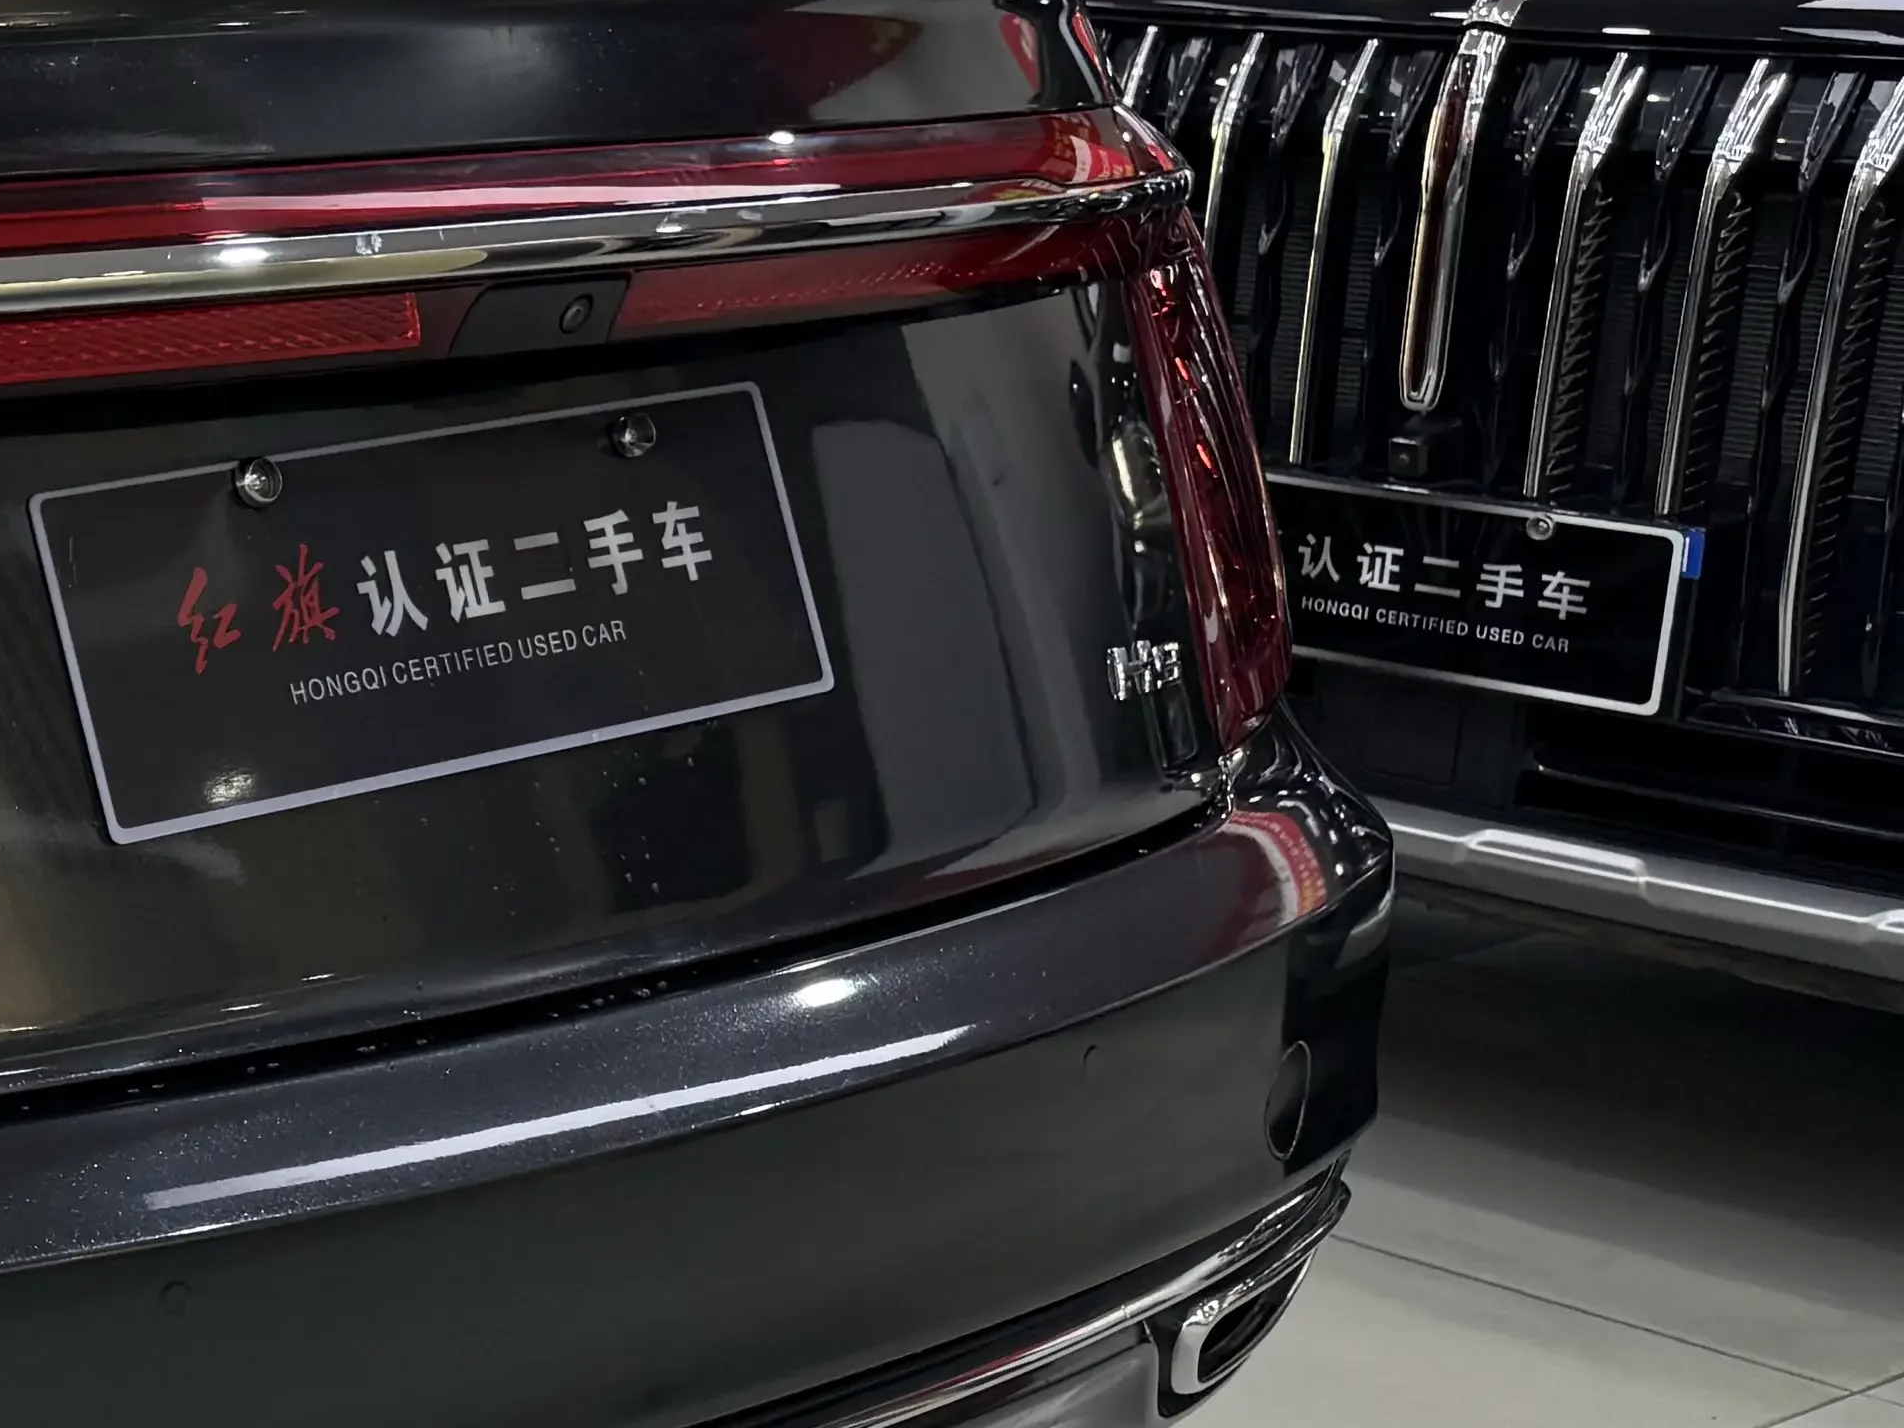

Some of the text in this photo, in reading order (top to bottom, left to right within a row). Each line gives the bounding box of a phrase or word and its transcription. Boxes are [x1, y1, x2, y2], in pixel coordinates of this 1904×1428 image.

[1297, 533, 1591, 620] 认证二手车
[290, 619, 627, 704] HONGQI CERTIFIED USED CAR
[1301, 595, 1570, 653] HONGQI CERTIFIED USED CAR
